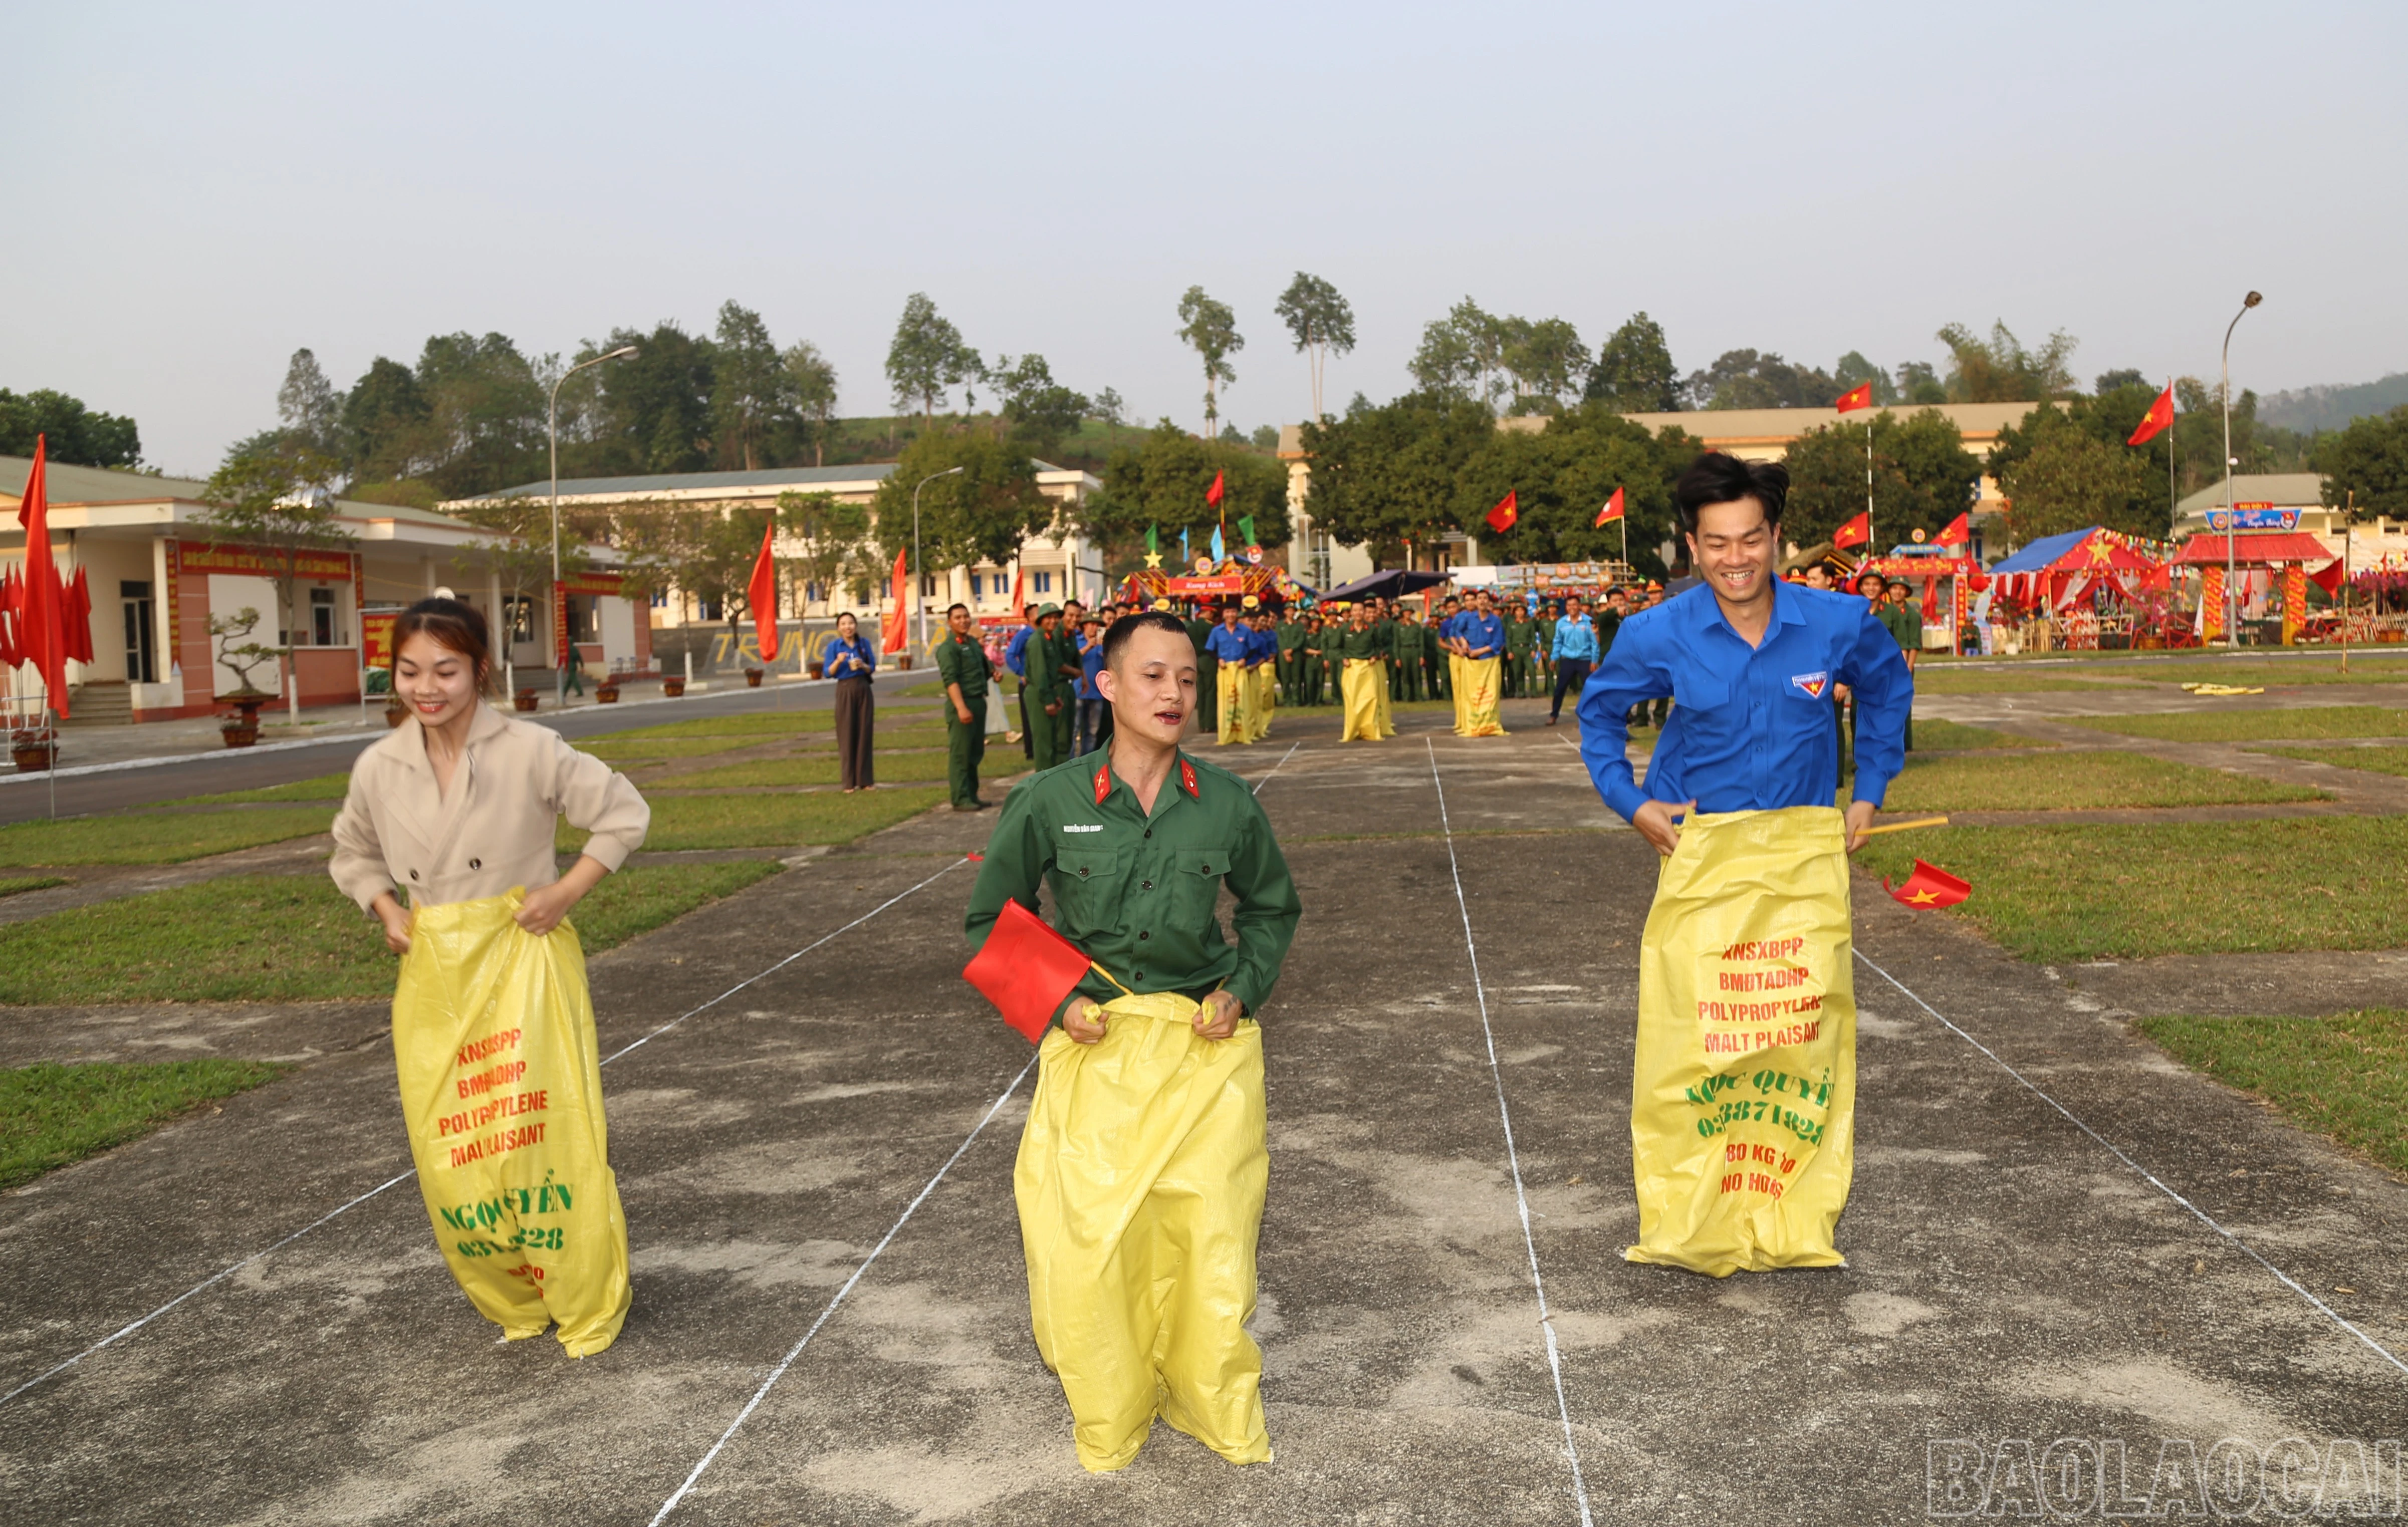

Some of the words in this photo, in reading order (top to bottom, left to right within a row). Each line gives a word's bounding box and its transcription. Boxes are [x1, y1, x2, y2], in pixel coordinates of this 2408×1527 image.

[1705, 1033, 1750, 1053] MALT
[1756, 1021, 1820, 1050] PLAISANT
[1752, 1144, 1776, 1166] KG
[1721, 1173, 1743, 1194] NO
